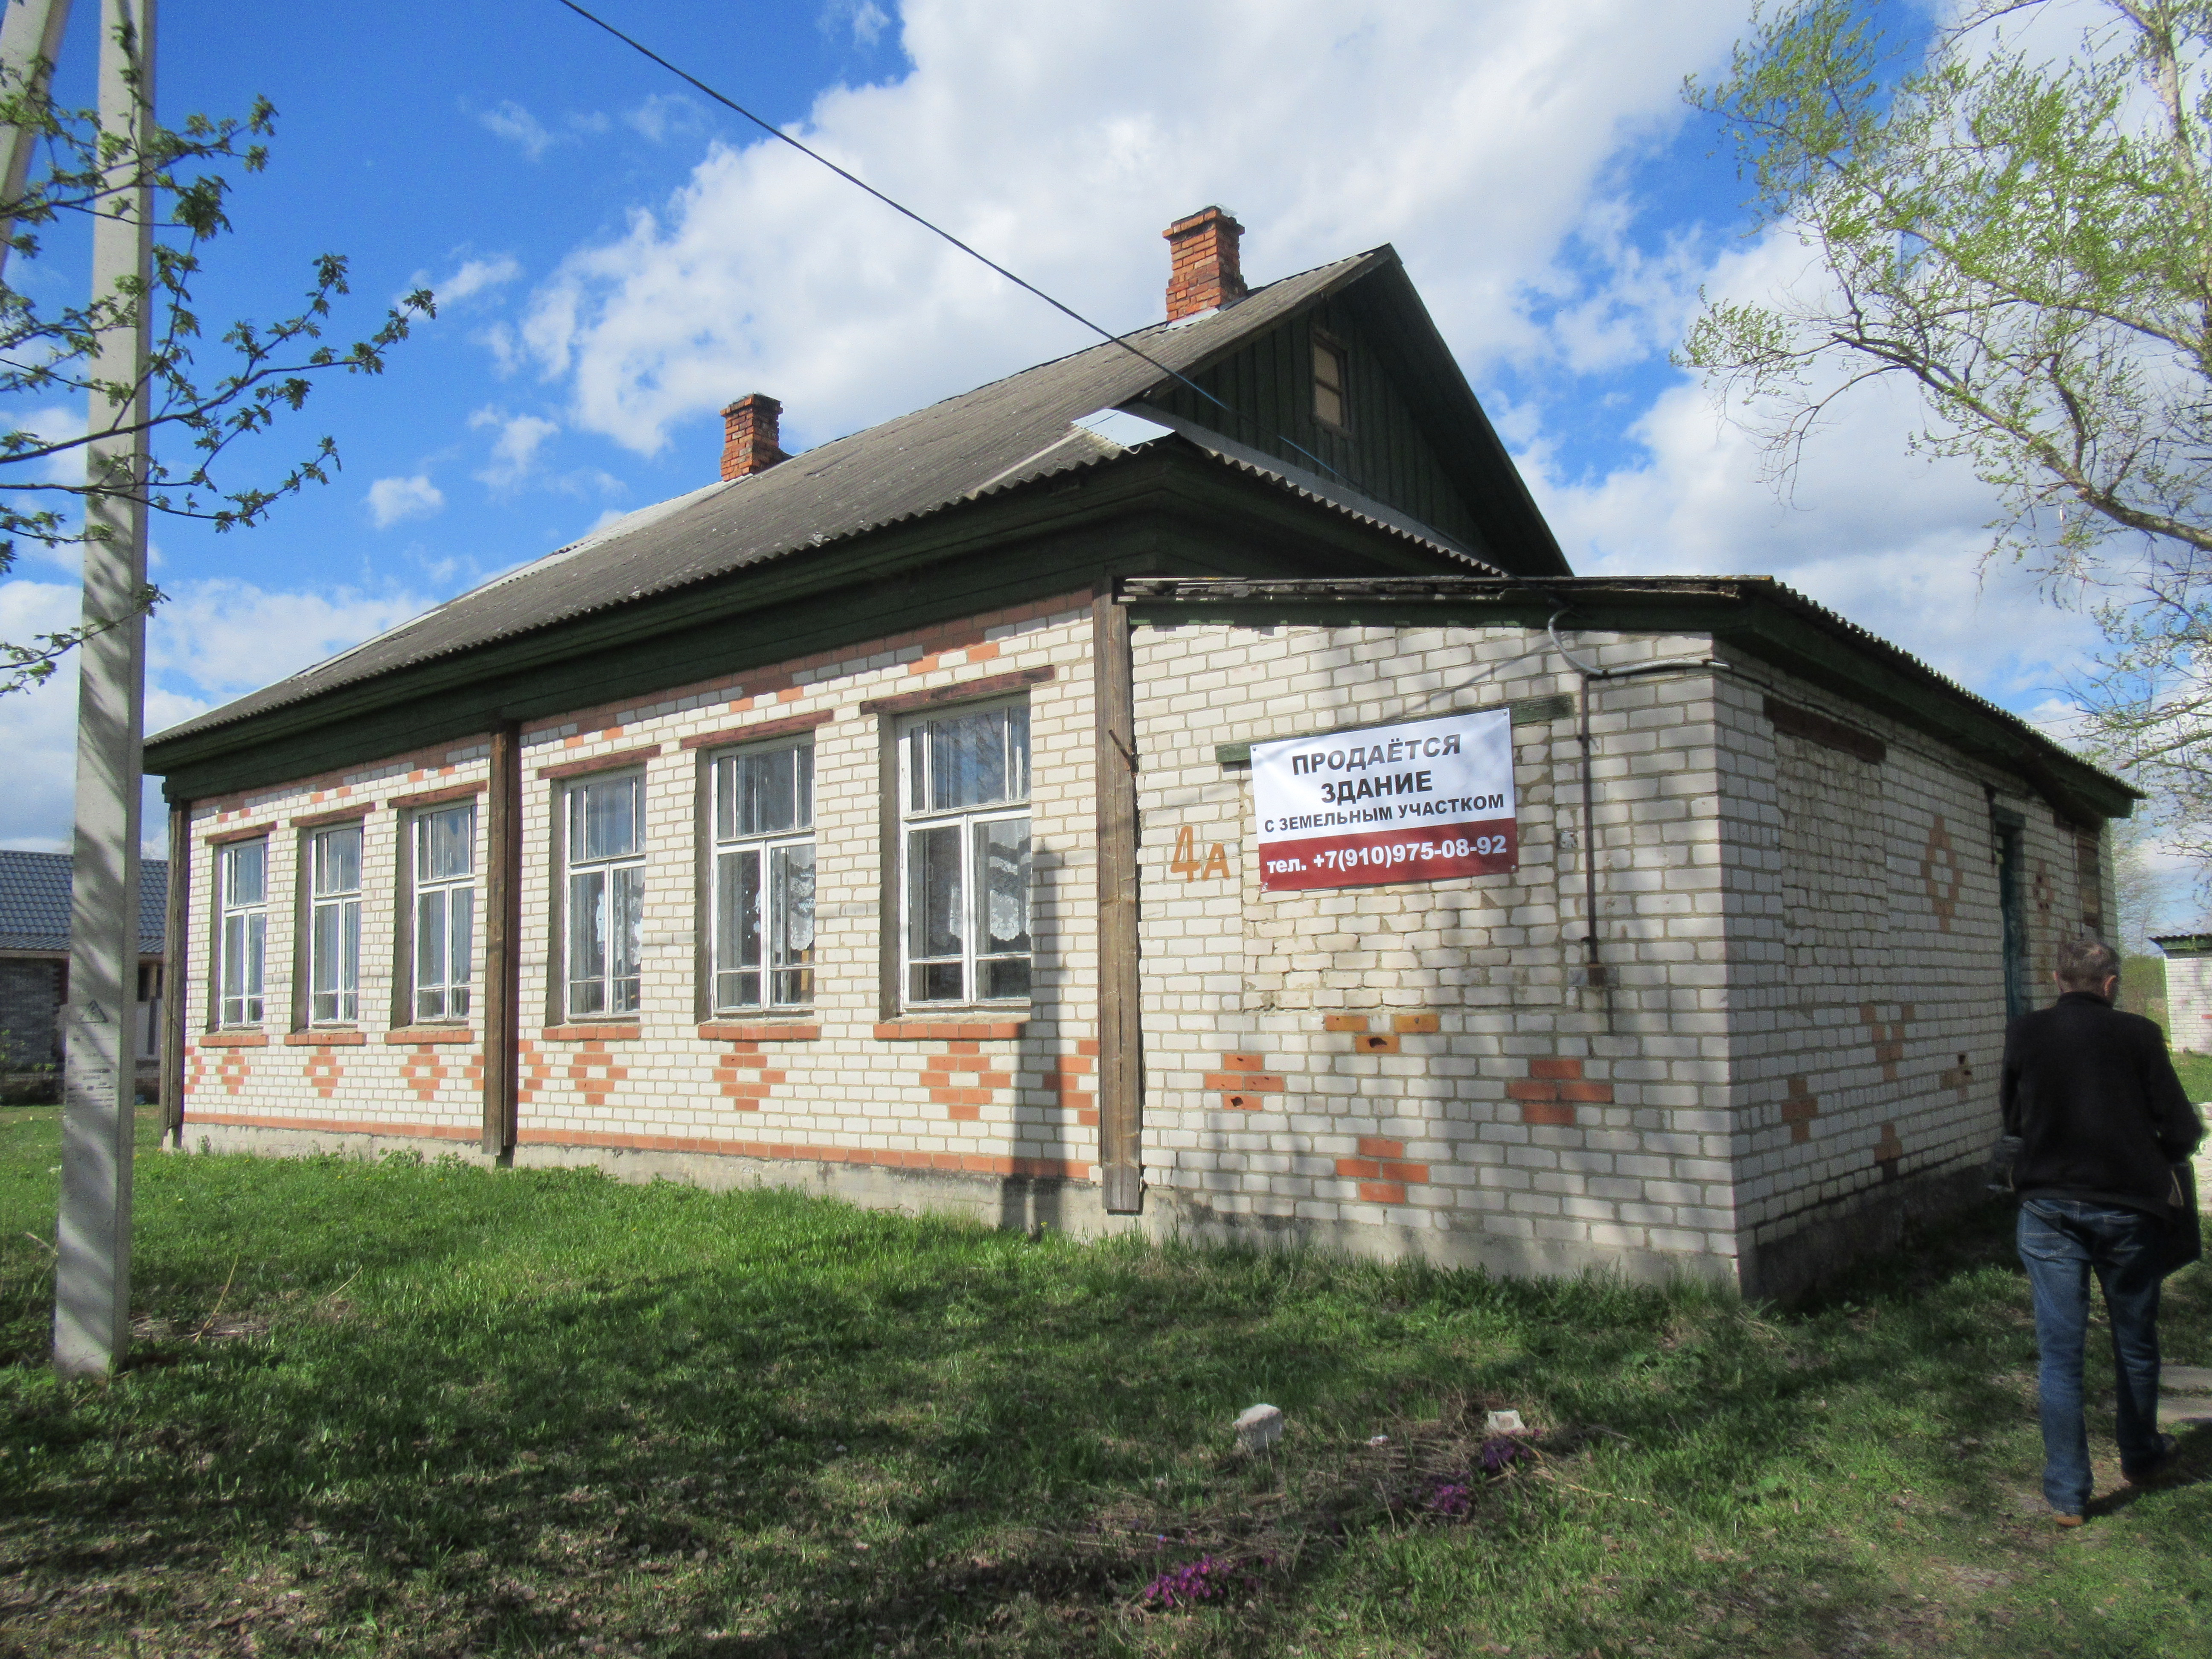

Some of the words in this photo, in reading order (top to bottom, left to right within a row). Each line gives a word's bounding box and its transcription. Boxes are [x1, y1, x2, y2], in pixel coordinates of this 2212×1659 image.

[1292, 734, 1460, 775] ПРОДАЁТСЯ
[1321, 770, 1433, 806] ЗДАНИЕ
[1265, 819, 1275, 832] С
[1279, 806, 1392, 831] ЗЕМЕЛЬНЫМ
[1398, 794, 1504, 818] УЧАСТКОМ
[1266, 858, 1307, 873] тел.
[1313, 835, 1507, 872] +7(910)975-08-92
